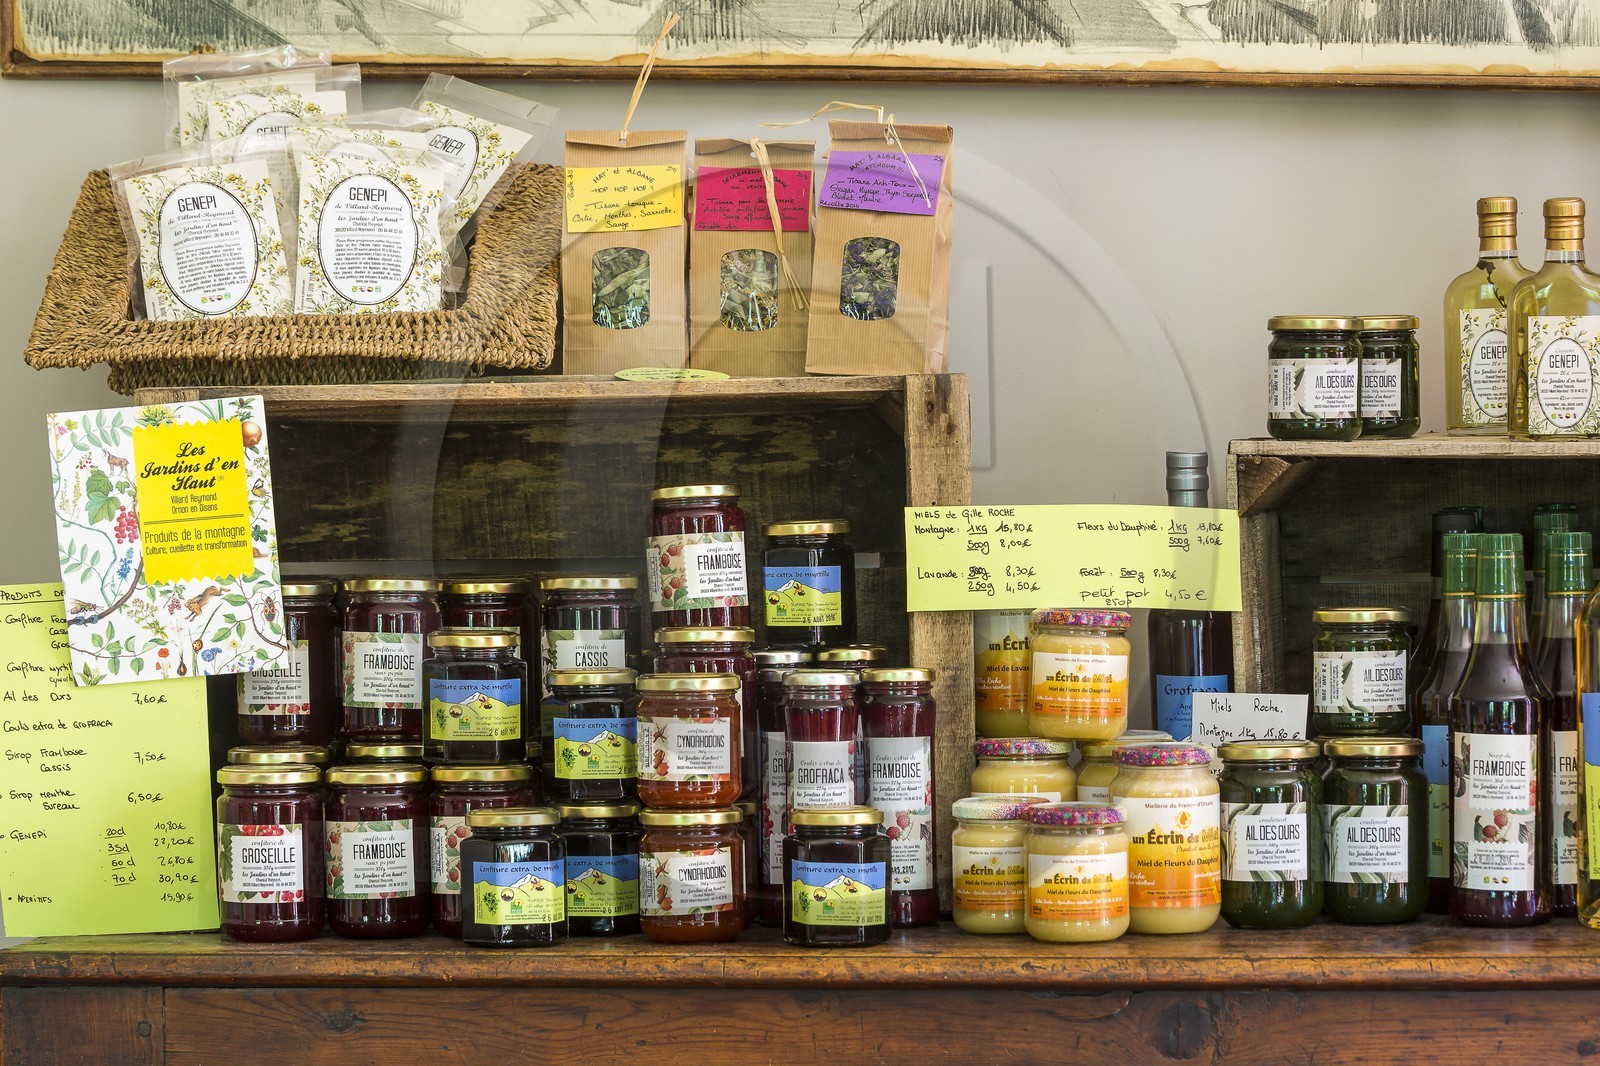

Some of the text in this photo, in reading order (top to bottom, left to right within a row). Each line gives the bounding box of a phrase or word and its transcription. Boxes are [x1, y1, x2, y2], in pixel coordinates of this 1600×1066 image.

[429, 134, 465, 156] GENEPI
[349, 187, 387, 202] GENEPI
[178, 196, 216, 212] GENEPI
[1481, 346, 1507, 360] GENEP
[1549, 354, 1579, 368] GENEPI
[1327, 375, 1340, 388] DES
[1340, 375, 1354, 388] OURS
[1380, 375, 1397, 388] OURS
[176, 442, 205, 458] Les
[140, 461, 201, 478] Jardins
[172, 475, 216, 491] Haut
[171, 493, 217, 504] Villard Reymond
[172, 506, 189, 514] Ornon
[200, 504, 218, 512] Oisans
[946, 511, 957, 519] de
[962, 509, 983, 524] Gille
[988, 509, 1015, 517] ROCHE
[996, 521, 1033, 533] 15,80€
[1077, 522, 1104, 531] Fleurs
[1108, 522, 1119, 531] du
[144, 526, 245, 543] Produits de la montagne
[146, 546, 168, 555] Culture,
[170, 544, 194, 553] cueillette
[205, 540, 247, 550] transformation
[967, 539, 1032, 555] 500g 8,00€
[1169, 536, 1223, 552] 500g 7,60€
[697, 553, 742, 571] FRAMBOISE
[1006, 566, 1036, 577] 8,30€
[1120, 568, 1145, 583] 500g
[1154, 569, 1177, 580] 8,30€
[968, 582, 1040, 596] 250g 4,50€
[1125, 588, 1150, 602] pot
[989, 643, 1000, 651] un
[363, 654, 414, 670] FRAMBOISE
[575, 652, 608, 666] CASSIS
[1055, 672, 1080, 682] Écrin
[1375, 668, 1387, 682] DES
[1389, 667, 1403, 681] OURS
[481, 682, 490, 690] de
[22, 691, 38, 701] des
[132, 693, 167, 705] 7,60€
[1211, 698, 1232, 713] Miels
[33, 719, 54, 730] extra
[58, 719, 67, 729] de
[1199, 723, 1233, 741] Montagne
[677, 736, 724, 748] CYNORHODONS
[5, 750, 32, 763] Sirop
[134, 752, 166, 764] 7,50€
[40, 763, 71, 772] Cassis
[872, 762, 921, 779] FRAMBOISE
[1473, 760, 1526, 777] FRAMBOISE
[798, 768, 844, 783] GROFRACA
[9, 790, 33, 803] Sirop
[127, 792, 163, 804] 6,50€
[1132, 837, 1144, 845] un
[1147, 829, 1184, 845] Écrin
[1187, 834, 1199, 843] de
[1246, 824, 1300, 840] AIL DES OURS
[1347, 826, 1401, 842] AIL DES OURS
[154, 836, 195, 849] 22,20€
[242, 848, 295, 863] GROSEILLE
[353, 842, 406, 860] FRAMBOISE
[158, 856, 194, 867] 26,80€
[1164, 859, 1184, 867] Fleurs
[1186, 859, 1195, 867] du
[159, 872, 199, 885] 30,90€
[678, 864, 726, 882] CYNORHODONS
[1053, 873, 1079, 885] Écrin
